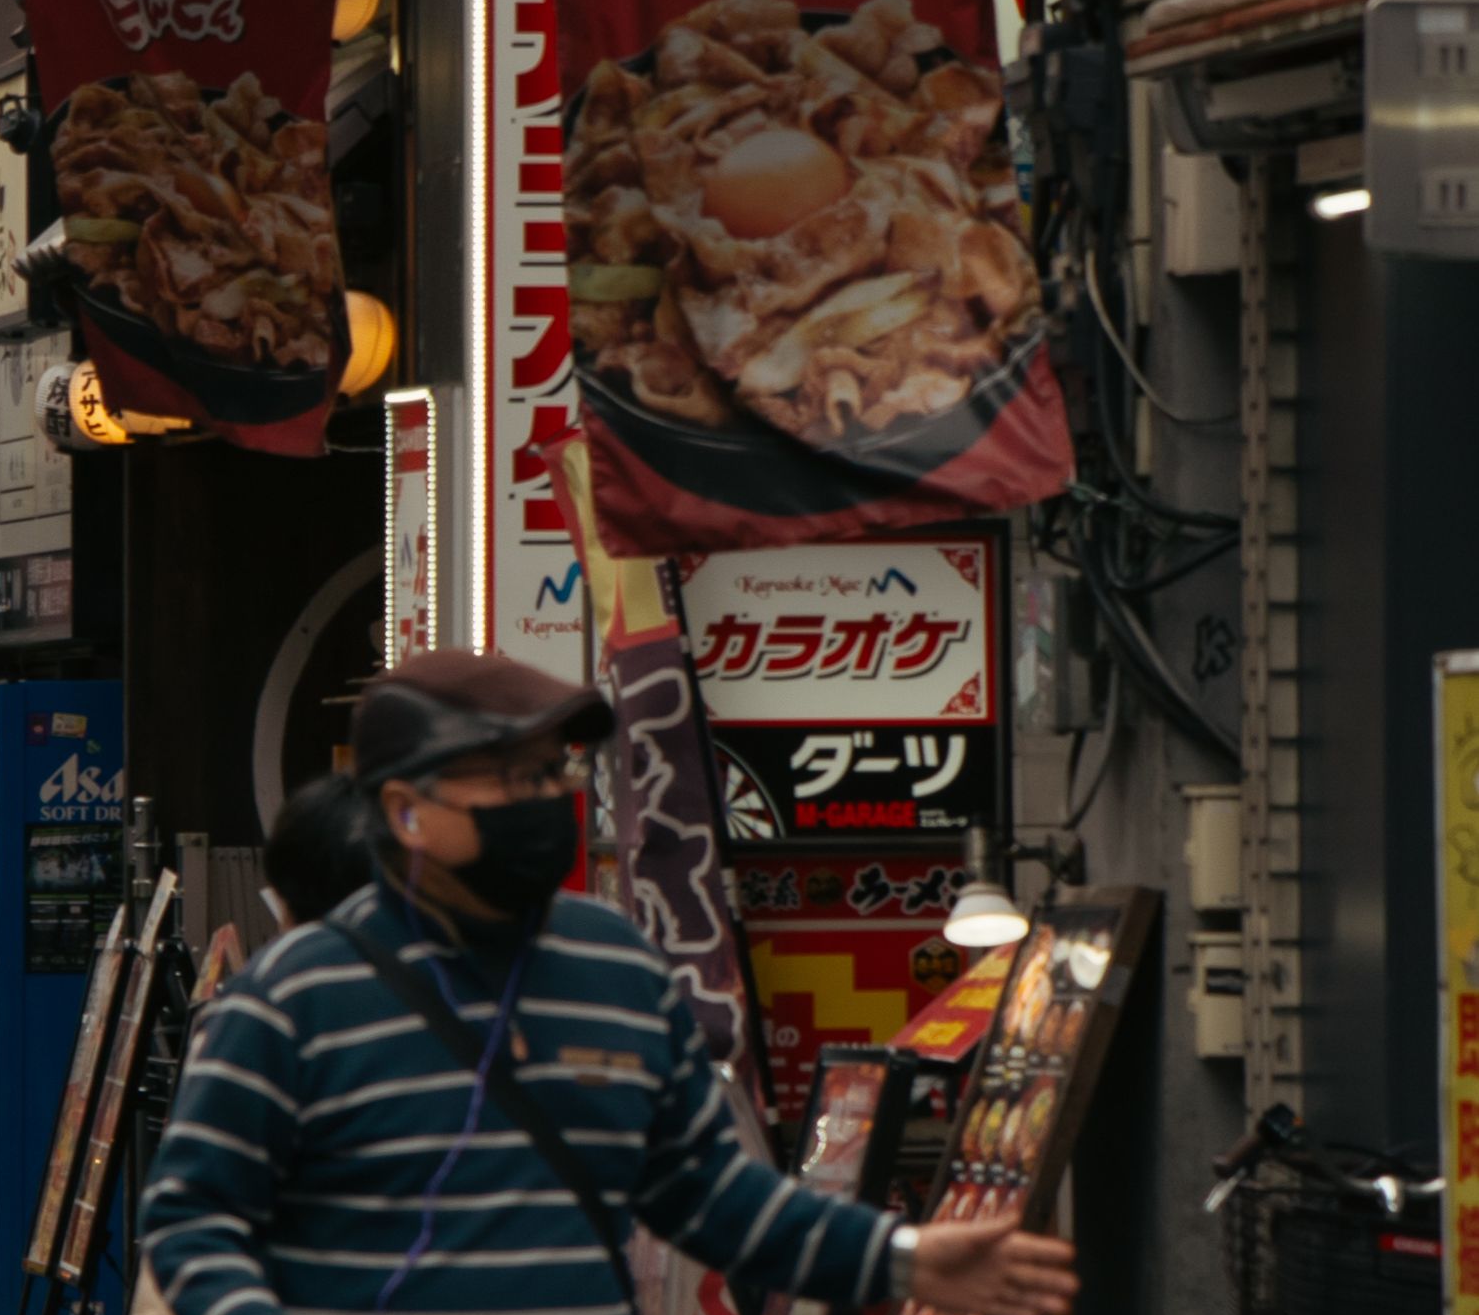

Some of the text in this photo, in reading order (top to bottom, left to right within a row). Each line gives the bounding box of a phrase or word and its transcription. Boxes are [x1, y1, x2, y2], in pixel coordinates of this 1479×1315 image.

[735, 574, 816, 598] Karaoke
[515, 617, 584, 636] Karaok
[695, 612, 966, 678] カラオケ
[39, 751, 125, 805] Asa
[790, 731, 969, 799] ダーツ
[40, 805, 90, 822] SOFT
[794, 800, 917, 829] M-GARAGE
